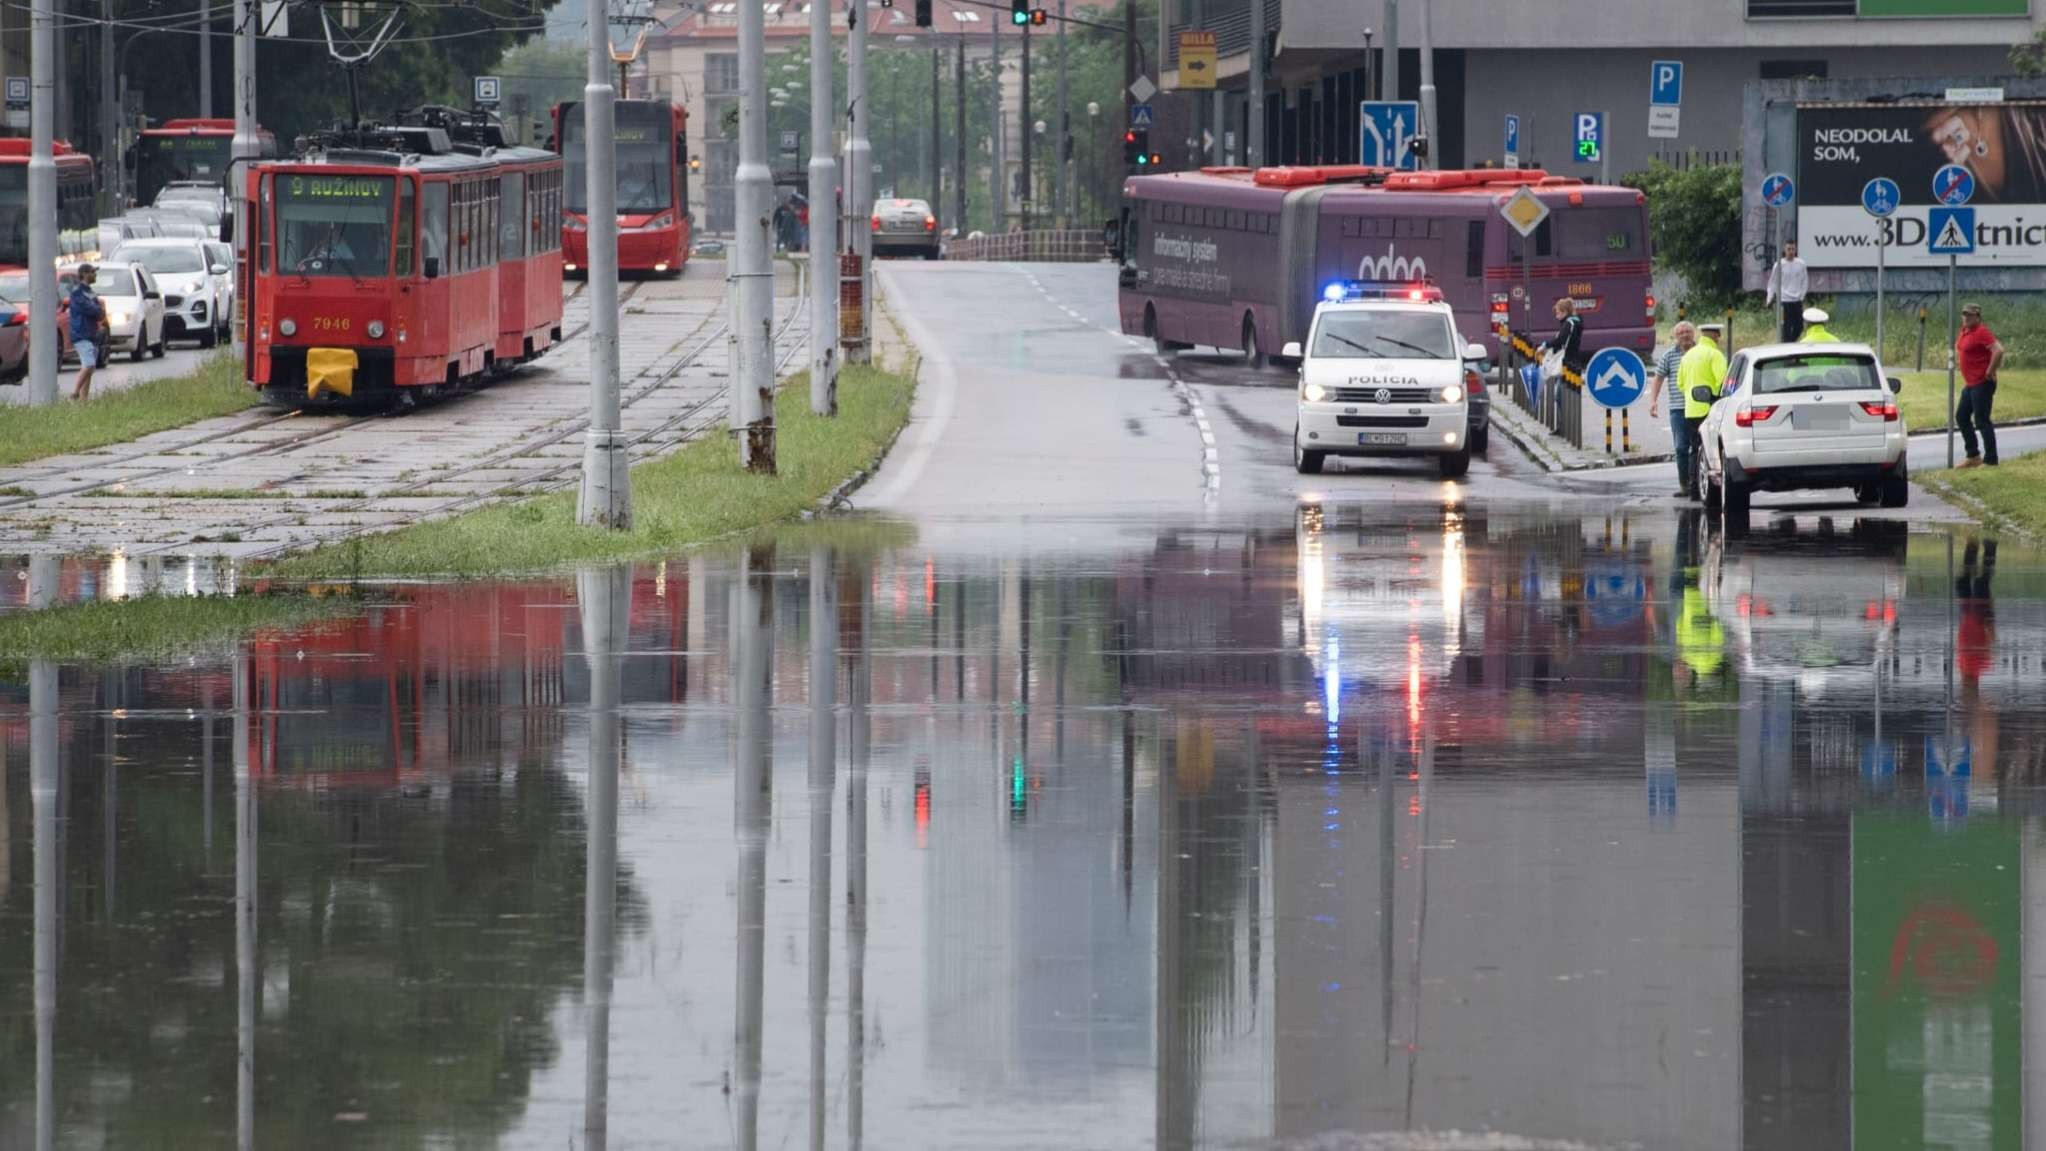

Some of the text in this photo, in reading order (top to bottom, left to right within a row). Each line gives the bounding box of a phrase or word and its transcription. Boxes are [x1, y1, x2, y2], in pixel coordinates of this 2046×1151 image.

[1660, 66, 1674, 92] P
[1508, 119, 1516, 142] P
[1578, 114, 1597, 140] P
[1814, 128, 1913, 143] NEODOLAL
[1813, 146, 1861, 163] SOM,
[292, 176, 303, 195] 9
[312, 317, 350, 329] 7946
